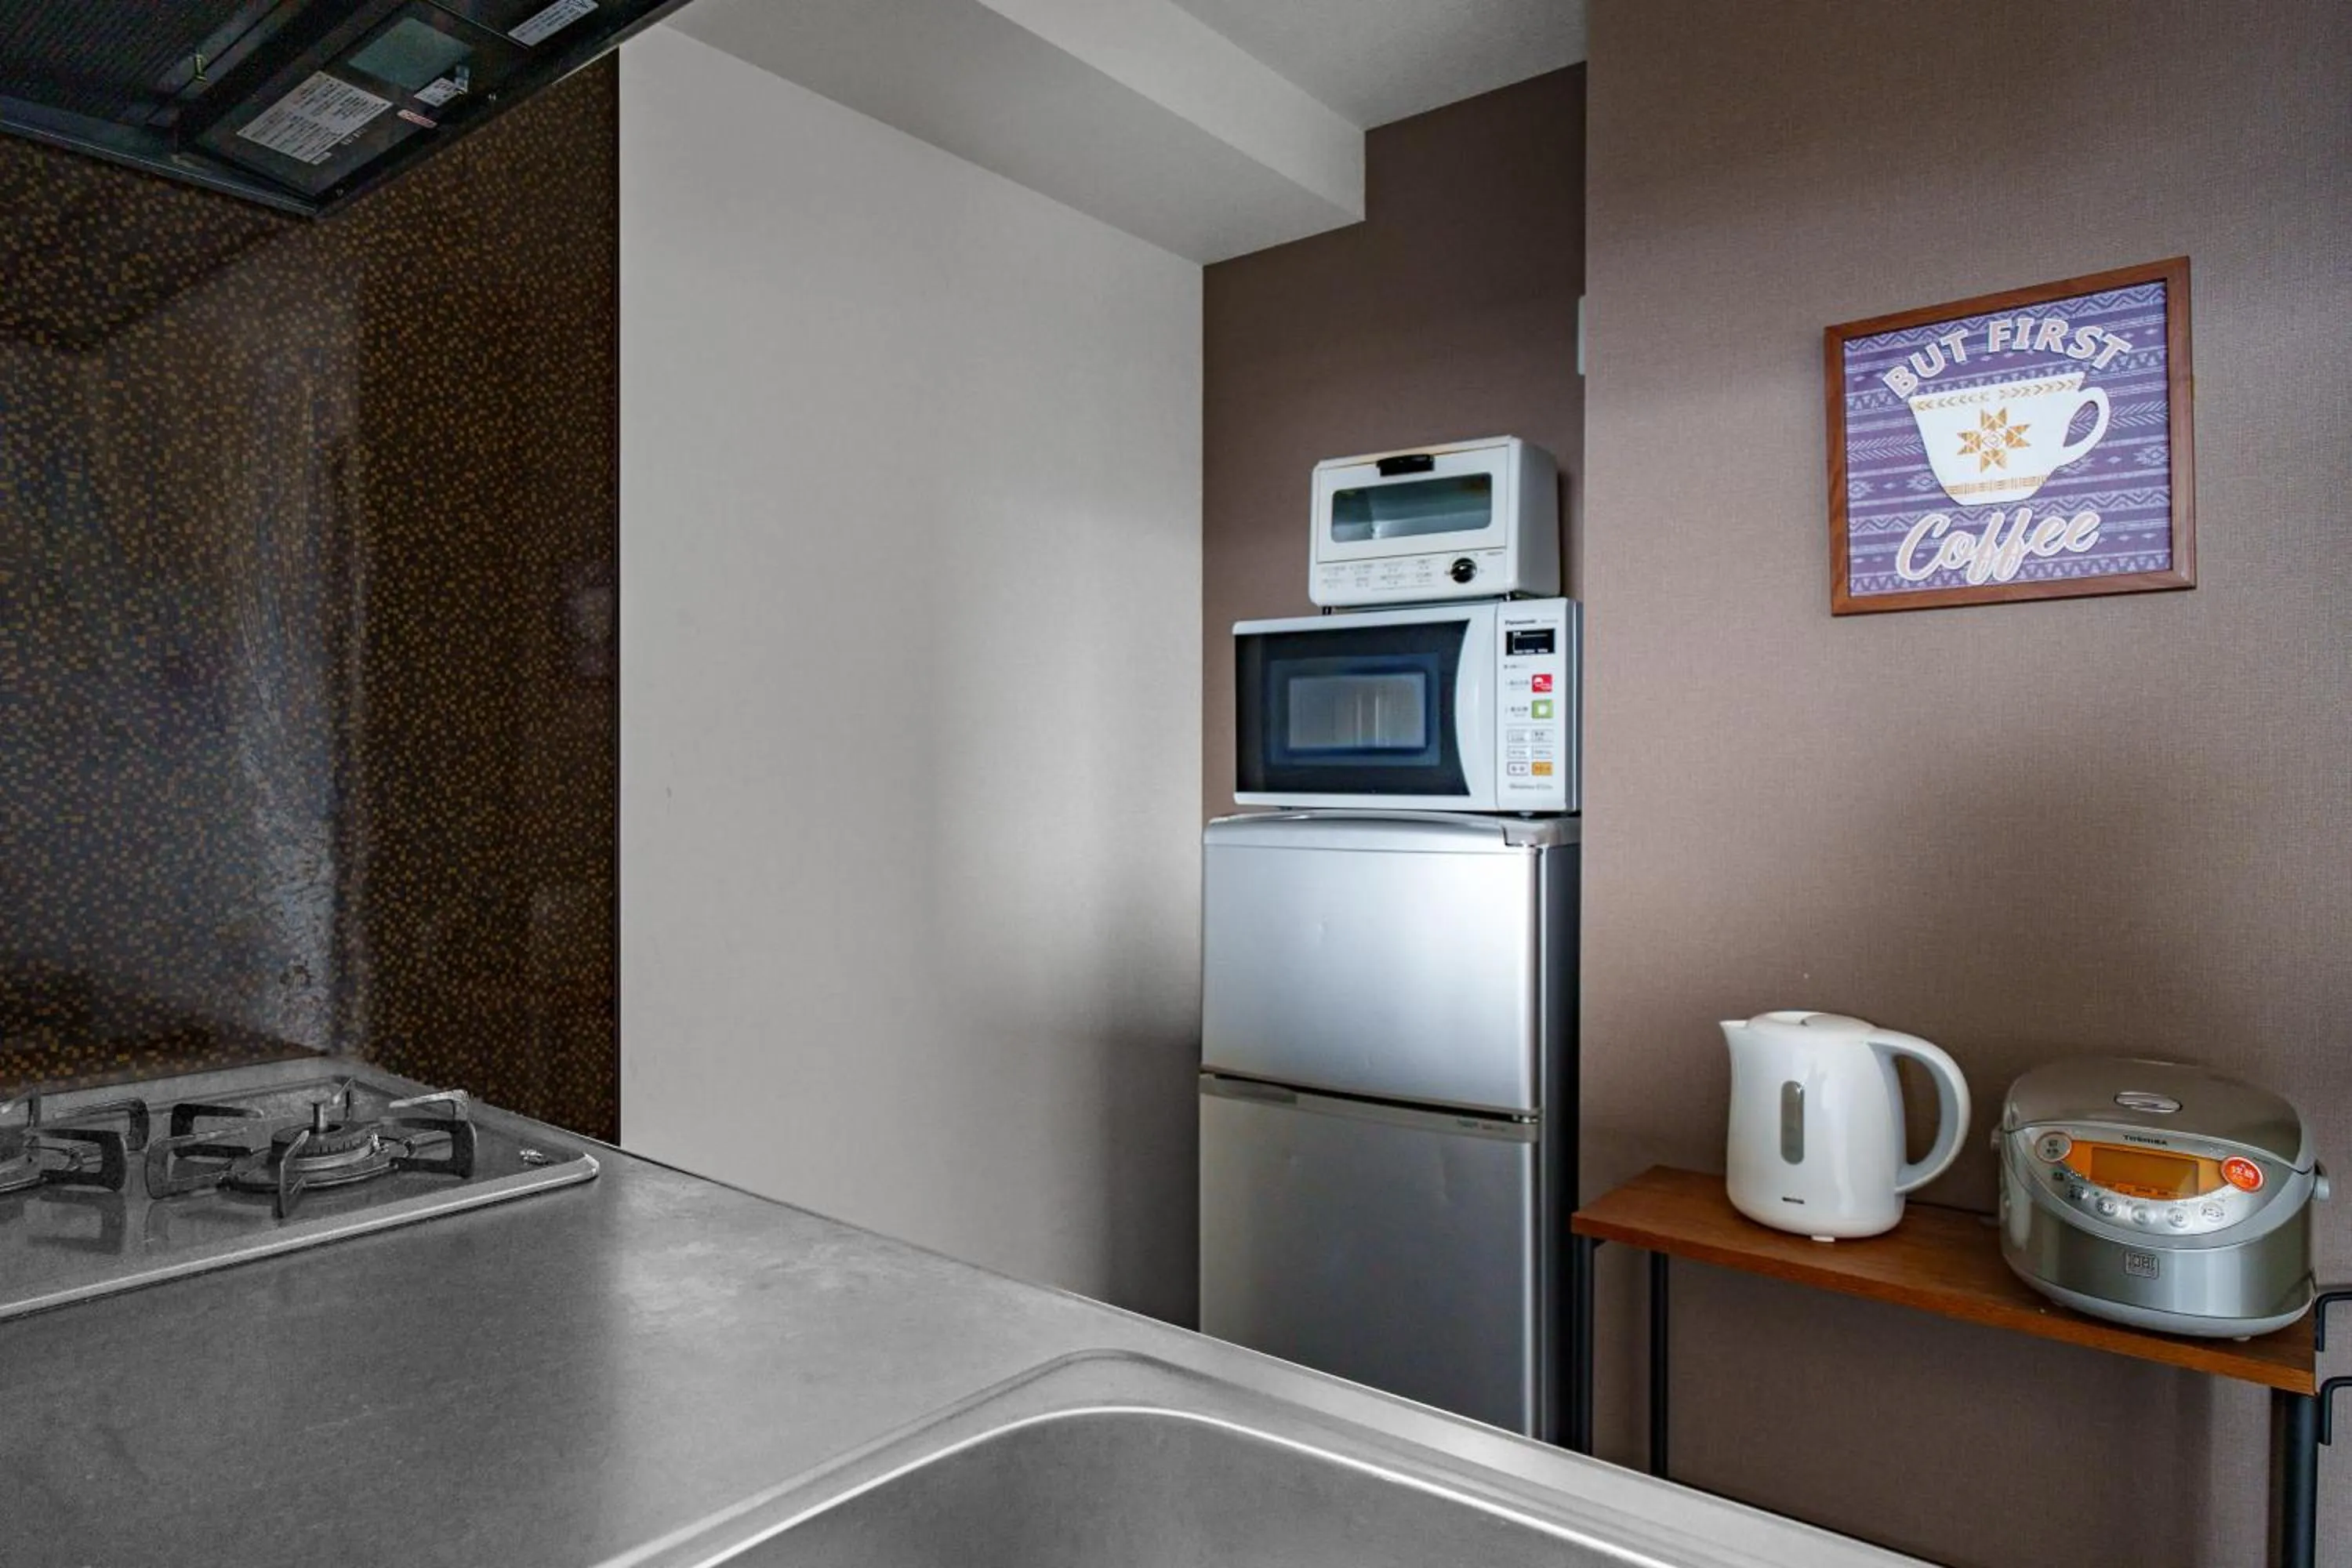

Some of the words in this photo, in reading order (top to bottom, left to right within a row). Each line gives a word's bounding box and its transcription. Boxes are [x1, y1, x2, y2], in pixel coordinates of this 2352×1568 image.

[1882, 329, 1970, 398] BUT
[1987, 317, 2132, 370] FIRST
[1895, 507, 2102, 585] Coffee
